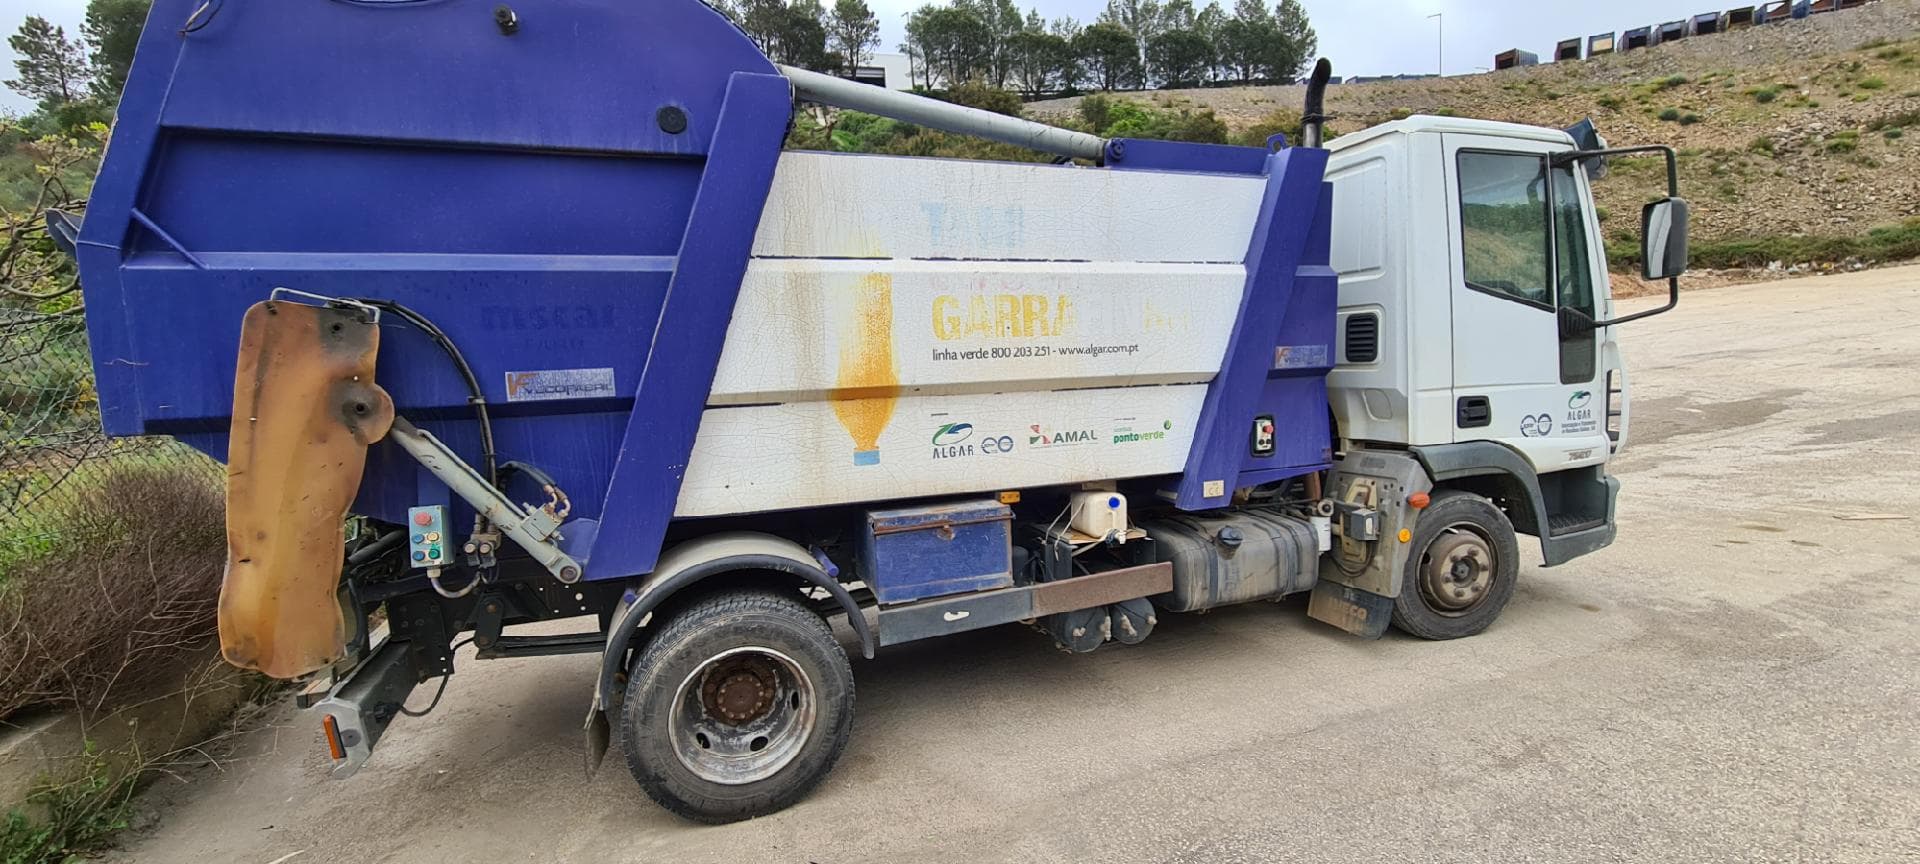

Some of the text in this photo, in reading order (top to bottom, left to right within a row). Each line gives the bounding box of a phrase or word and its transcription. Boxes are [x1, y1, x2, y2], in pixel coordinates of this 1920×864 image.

[932, 348, 958, 360] linha
[960, 348, 989, 359] verde
[991, 347, 1011, 359] 800
[1013, 346, 1033, 358] 203
[1034, 345, 1051, 357] 251
[1058, 343, 1140, 357] www.algar.com.pt
[1567, 409, 1592, 421] ALGAR
[1053, 430, 1099, 444] AMAL
[932, 445, 974, 459] ALGAR
